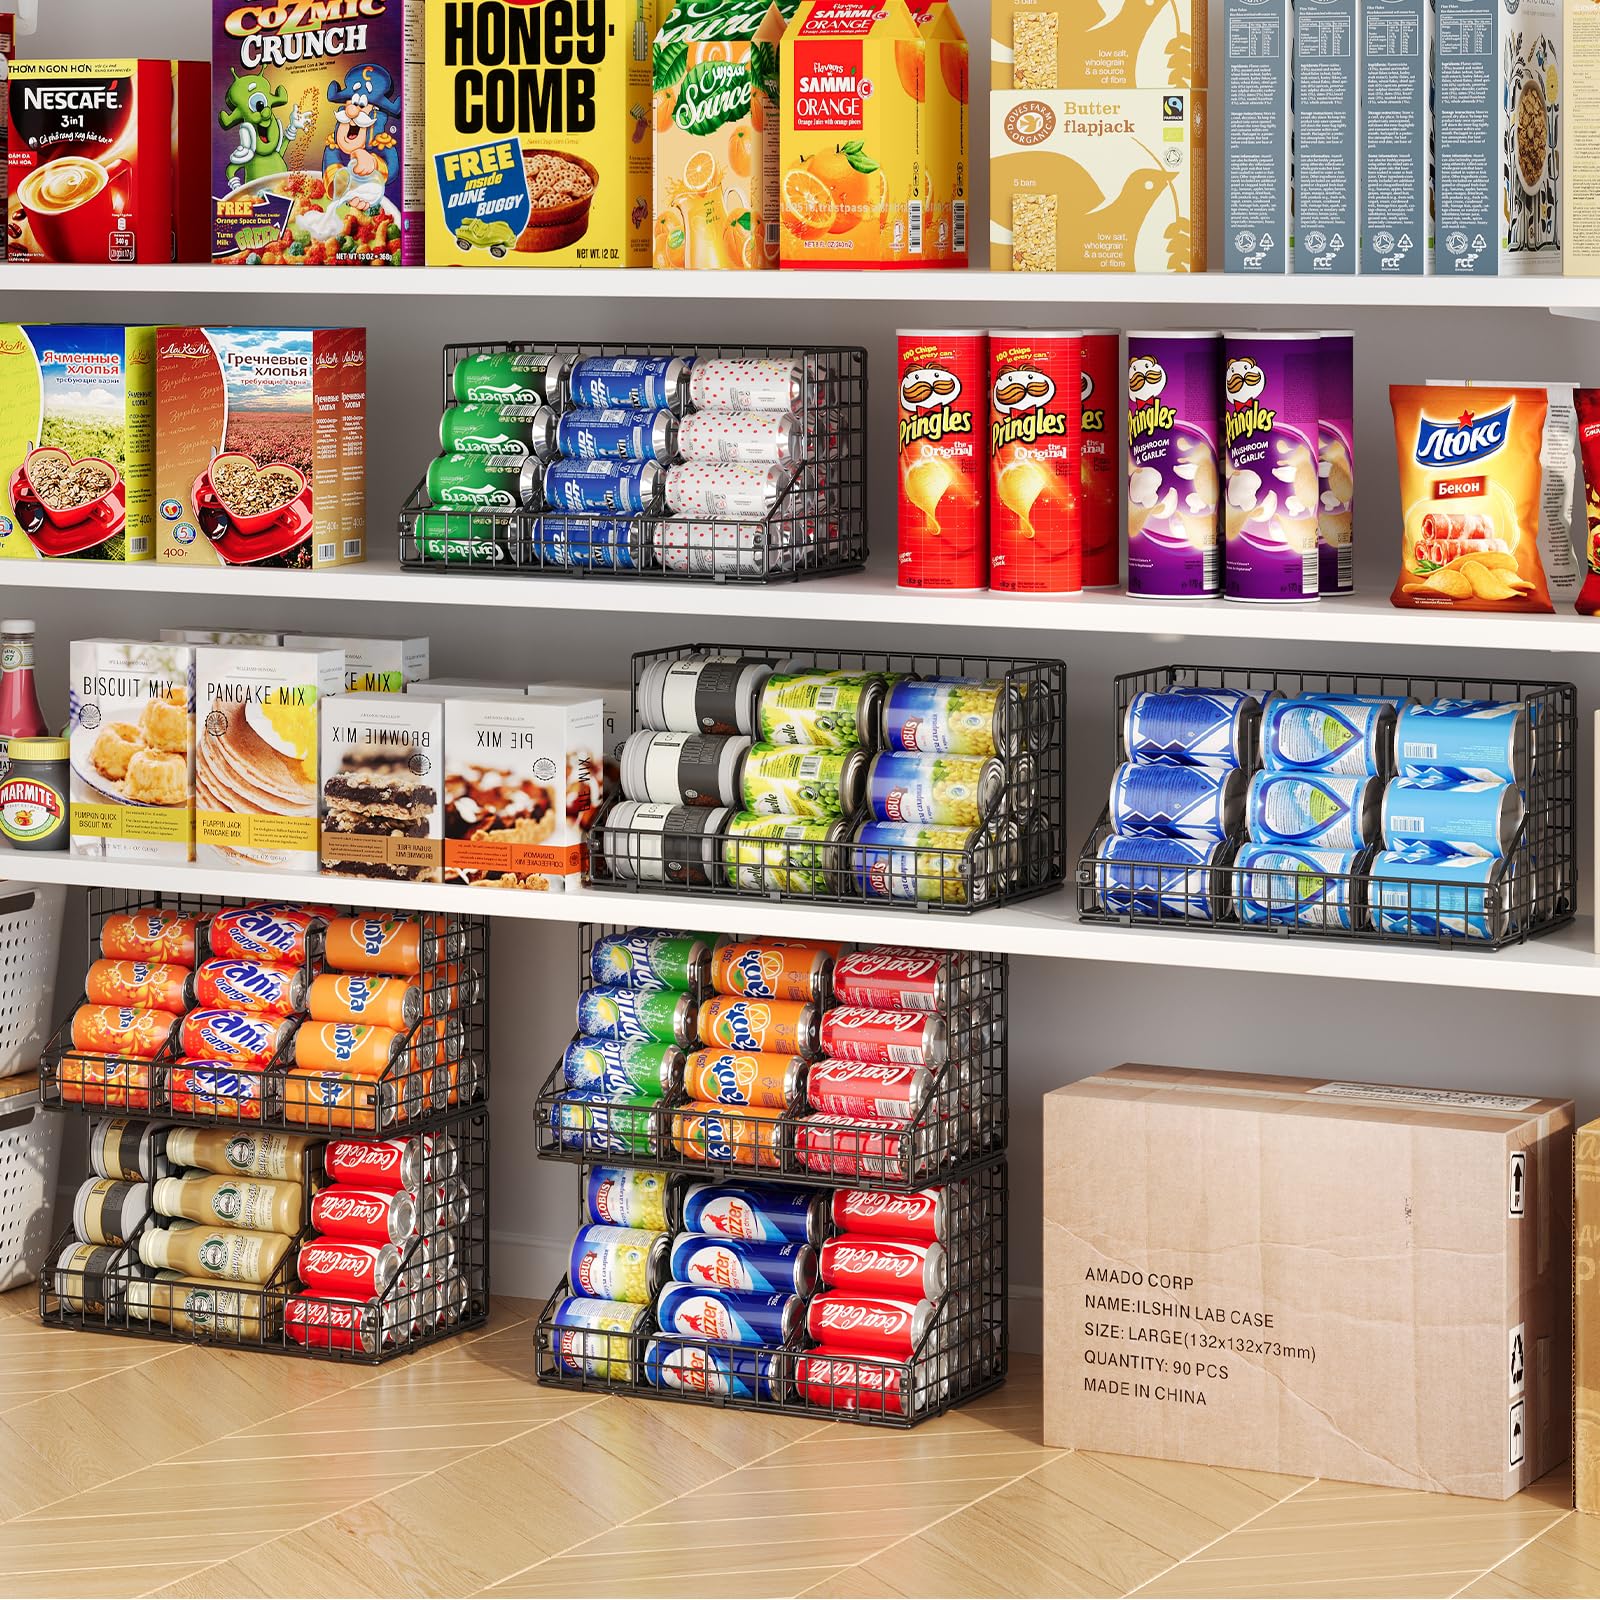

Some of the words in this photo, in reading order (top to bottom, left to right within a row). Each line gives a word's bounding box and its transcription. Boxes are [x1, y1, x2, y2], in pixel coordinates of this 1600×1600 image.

[805, 19, 872, 30] ORANGE
[814, 9, 872, 19] SAMMI
[241, 25, 367, 68] CRUNCH
[1099, 50, 1112, 58] low
[8, 64, 36, 73] THƠM
[38, 64, 68, 73] NGON
[70, 64, 92, 73] HƠN
[1085, 59, 1125, 68] wholegrain
[800, 76, 856, 93] SAMMI
[454, 68, 596, 134] COMB
[676, 82, 750, 129] Source
[797, 98, 860, 116] ORANGE
[1030, 103, 1052, 121] FARM
[1064, 101, 1121, 115] Butter
[61, 115, 84, 128] 3in1
[1064, 120, 1135, 137] flapjack
[1012, 123, 1052, 145] ORGANIC
[443, 143, 515, 182] FREE
[464, 172, 503, 191] inside
[217, 201, 253, 216] FREE
[448, 188, 486, 208] DUNE
[476, 194, 524, 217] BUGGY
[239, 218, 256, 226] Space
[235, 226, 280, 250] GREEN
[1084, 242, 1124, 251] wholegrain
[1098, 233, 1111, 241] low
[44, 350, 119, 364] Ячменные
[227, 353, 308, 367] Гречневые
[915, 346, 938, 354] Chips
[1008, 347, 1031, 356] Chips
[67, 364, 119, 375] хлопья
[255, 367, 307, 377] хлопья
[468, 388, 542, 406] Carlsberg
[899, 406, 972, 456] Pringles
[992, 408, 1066, 456] Pringles
[1128, 398, 1176, 447] Pringles
[1226, 400, 1275, 449] Pringles
[454, 438, 530, 456] Carlsberg
[1417, 420, 1501, 460] Люкс
[921, 445, 973, 459] Original
[1014, 446, 1067, 461] Original
[1136, 457, 1141, 465] &
[1234, 459, 1240, 468] &
[441, 489, 517, 507] Carlsberg
[1438, 481, 1480, 496] Бекон
[429, 540, 504, 561] Carlsberg
[83, 676, 141, 698] BISCUIT
[149, 680, 174, 699] MIX
[207, 682, 272, 705] PANCAKE
[279, 687, 306, 706] MIX
[365, 673, 391, 692] MIX
[226, 821, 242, 830] JACK
[221, 907, 296, 951] Fanta
[229, 928, 267, 955] orange
[633, 936, 660, 990] Sprite
[744, 950, 775, 999] Fanta
[207, 959, 282, 1003] Fanta
[215, 978, 253, 1005] orange
[621, 989, 649, 1043] Sprite
[730, 1002, 762, 1052] Fanta
[192, 1009, 267, 1054] Fanta
[201, 1028, 239, 1055] orange
[606, 1041, 636, 1097] Sprite
[717, 1055, 749, 1106] Fanta
[333, 1143, 398, 1171] Coca-Cola
[320, 1196, 385, 1224] Coca-Cola
[597, 1183, 611, 1223] GLOBUS
[844, 1190, 931, 1221] Coca-Cola
[306, 1249, 372, 1278] Coca-Cola
[833, 1247, 919, 1278] Coca-Cola
[579, 1256, 593, 1295] GLOBUS
[1085, 1267, 1143, 1286] AMADO
[1148, 1273, 1194, 1291] CORP
[819, 1303, 907, 1335] Coca-Cola
[1085, 1294, 1190, 1319] NAME:ILSHIN
[1195, 1306, 1226, 1323] LAB
[1230, 1310, 1274, 1328] CASE
[1084, 1322, 1124, 1339] SIZE:
[1129, 1326, 1316, 1364] LARGE(132x132x73mm)
[1084, 1350, 1168, 1373] QUANTITY:
[1173, 1361, 1191, 1376] 90
[1196, 1363, 1229, 1380] PCS
[1084, 1378, 1130, 1396] MADE
[1134, 1384, 1150, 1398] IN
[1154, 1387, 1207, 1405] CHINA
